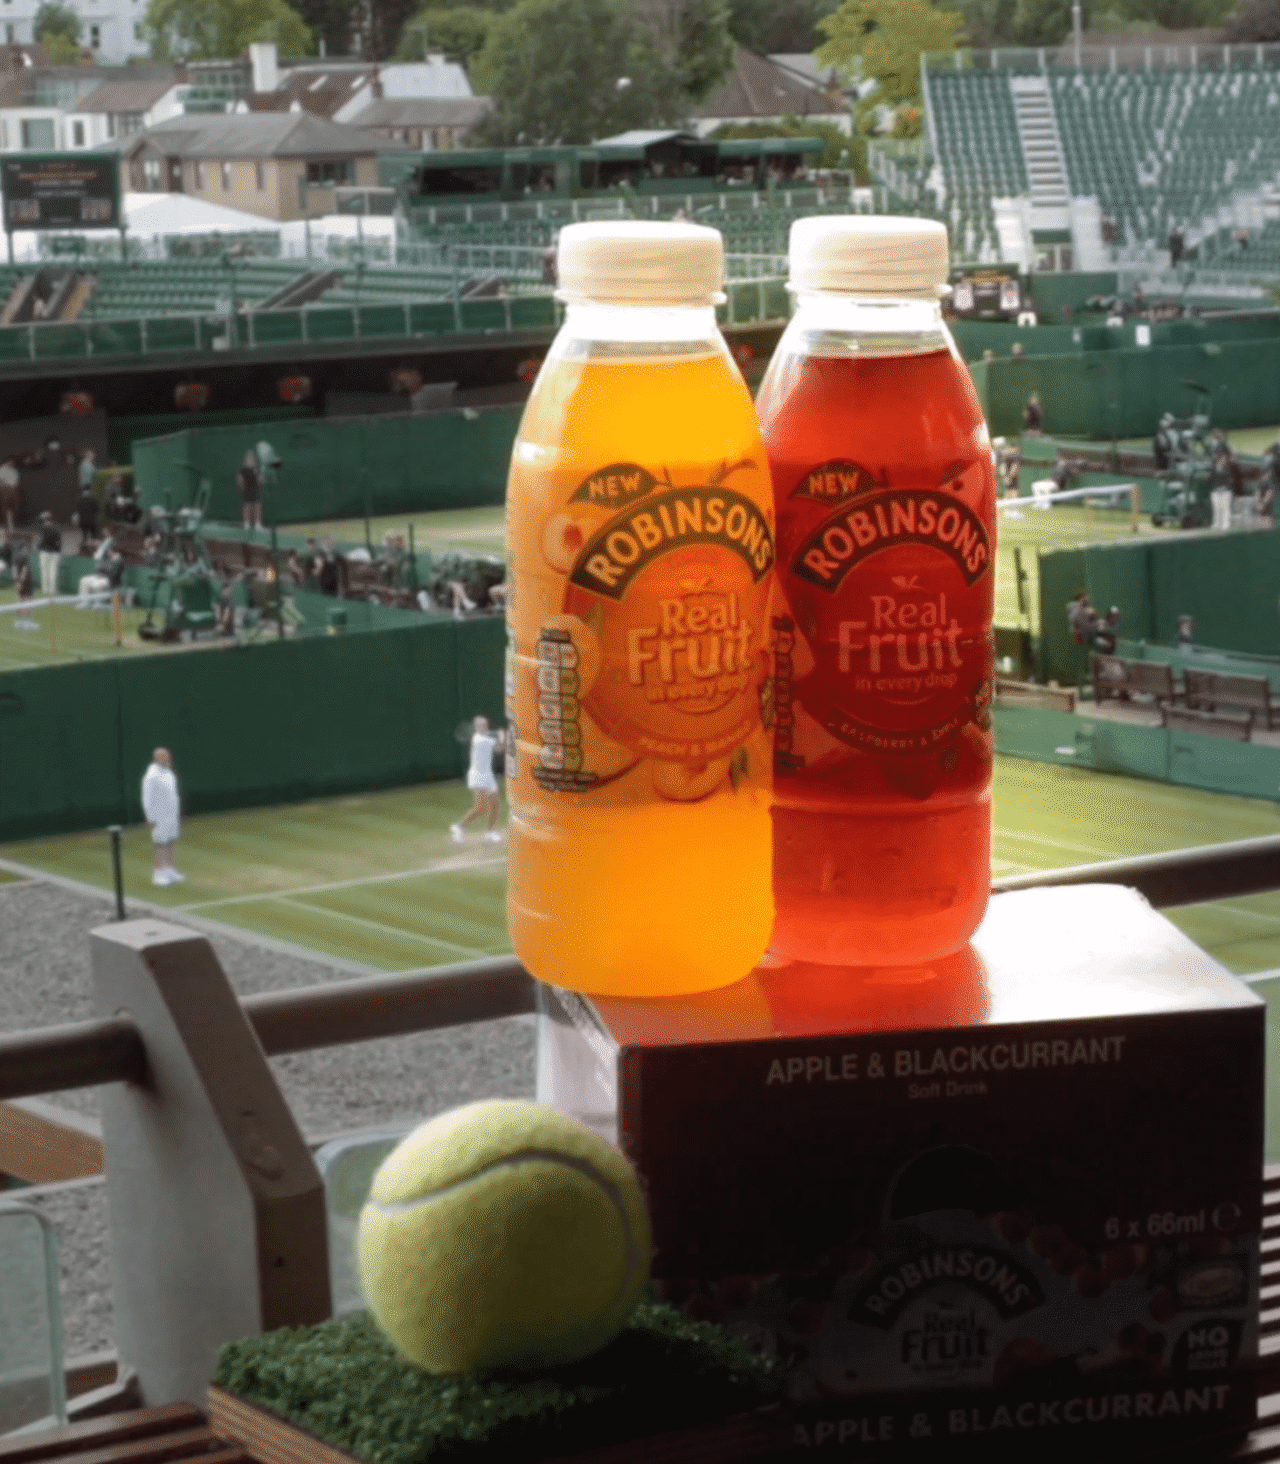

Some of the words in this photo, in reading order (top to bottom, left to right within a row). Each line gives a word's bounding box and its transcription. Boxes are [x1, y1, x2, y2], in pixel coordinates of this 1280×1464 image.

[588, 471, 643, 499] NEW
[808, 472, 859, 495] NEW
[585, 497, 771, 586] ROBINSONS
[804, 498, 987, 580] ROBINSONS
[659, 591, 739, 634] Real
[870, 591, 947, 630] Real
[628, 619, 753, 684] Fruit
[838, 618, 964, 673] Fruit
[855, 675, 872, 691] in
[875, 677, 922, 693] every
[925, 671, 958, 690] drop
[766, 1053, 859, 1085] APPLE
[866, 1052, 886, 1078] &
[895, 1035, 1127, 1077] BLACKCURRANT
[908, 1082, 940, 1100] Soft
[946, 1079, 989, 1097] Drink
[1104, 1216, 1120, 1240] 6
[1127, 1221, 1141, 1239] x
[864, 1250, 1030, 1316] ROBINSONS
[901, 1327, 989, 1364] Fruit
[1187, 1326, 1229, 1349] NO
[793, 1414, 895, 1448] APPLE
[908, 1412, 934, 1440] &
[948, 1383, 1231, 1435] BLACKCURRANT
